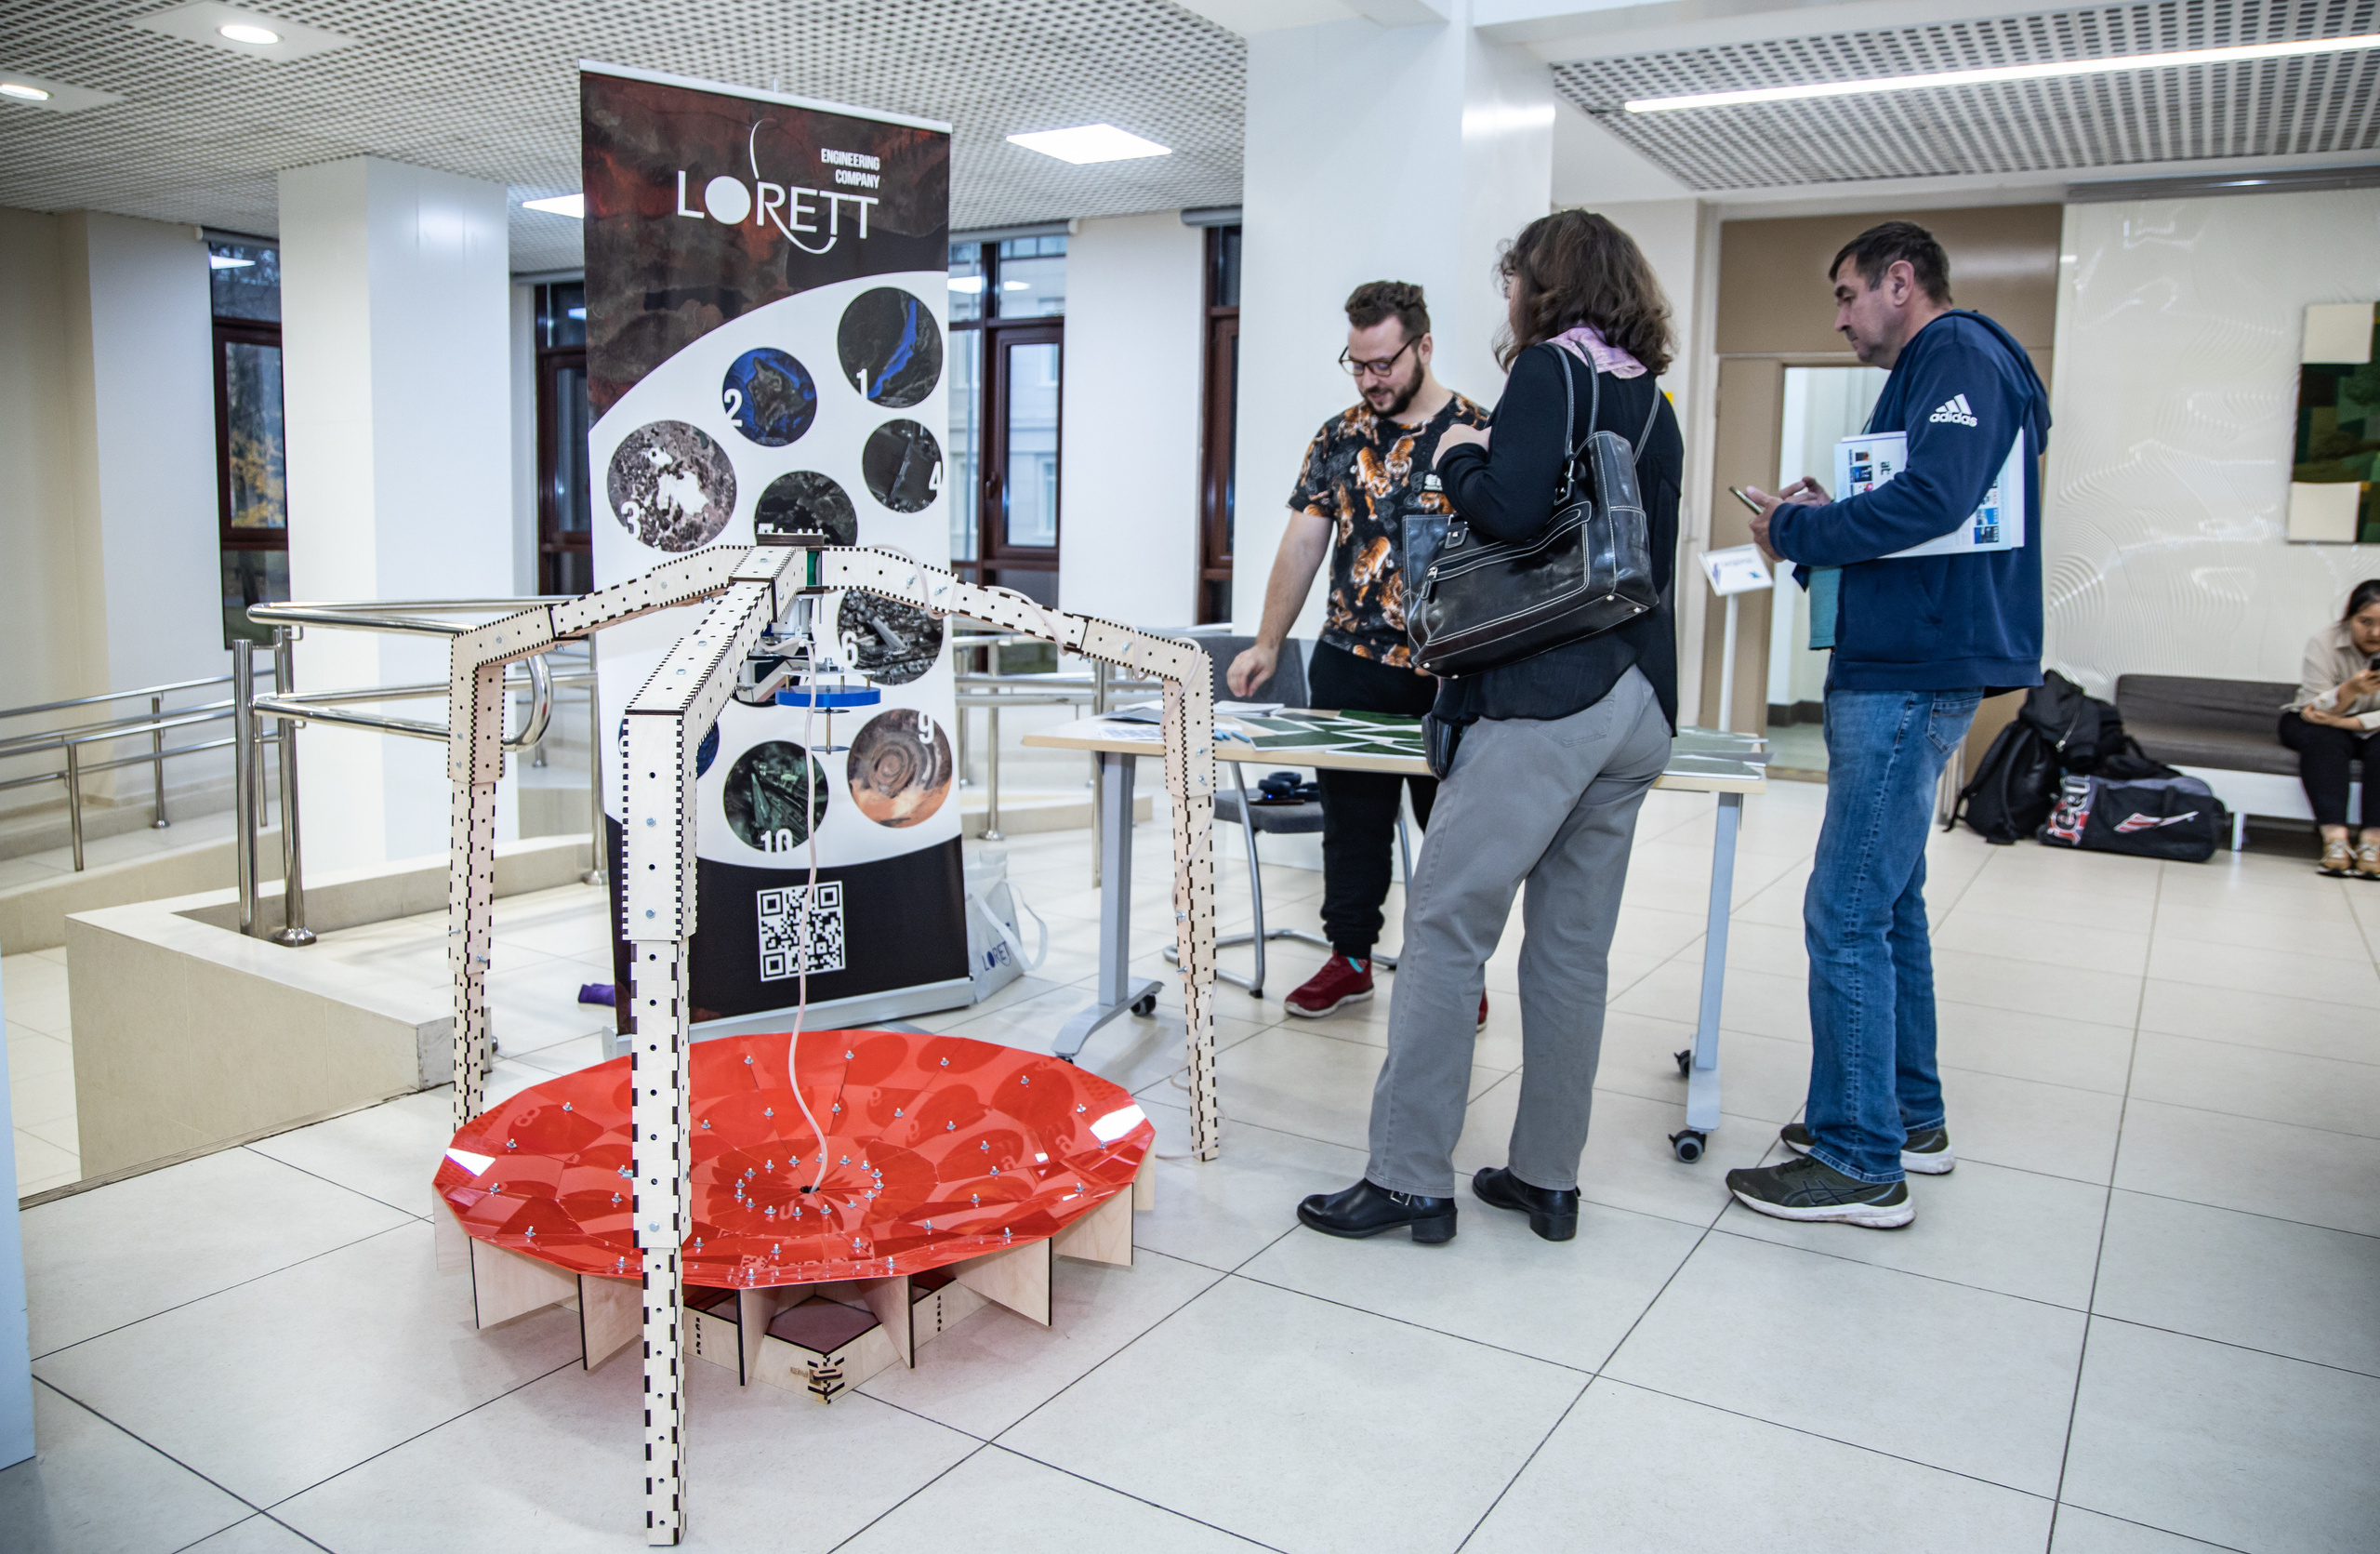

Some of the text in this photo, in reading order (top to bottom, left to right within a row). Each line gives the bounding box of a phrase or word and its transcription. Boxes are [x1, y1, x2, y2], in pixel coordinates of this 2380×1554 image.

[821, 148, 880, 171] ENGINEERING
[835, 168, 880, 189] COMPANY
[678, 169, 879, 254] LORETT
[856, 368, 867, 400] 1
[723, 388, 743, 427] 2
[1929, 410, 1977, 427] adidas
[928, 460, 943, 497] 4
[621, 500, 641, 540] 3
[840, 631, 858, 670] 6
[918, 708, 934, 745] 9
[760, 828, 793, 853] 10
[981, 940, 1011, 972] LORET
